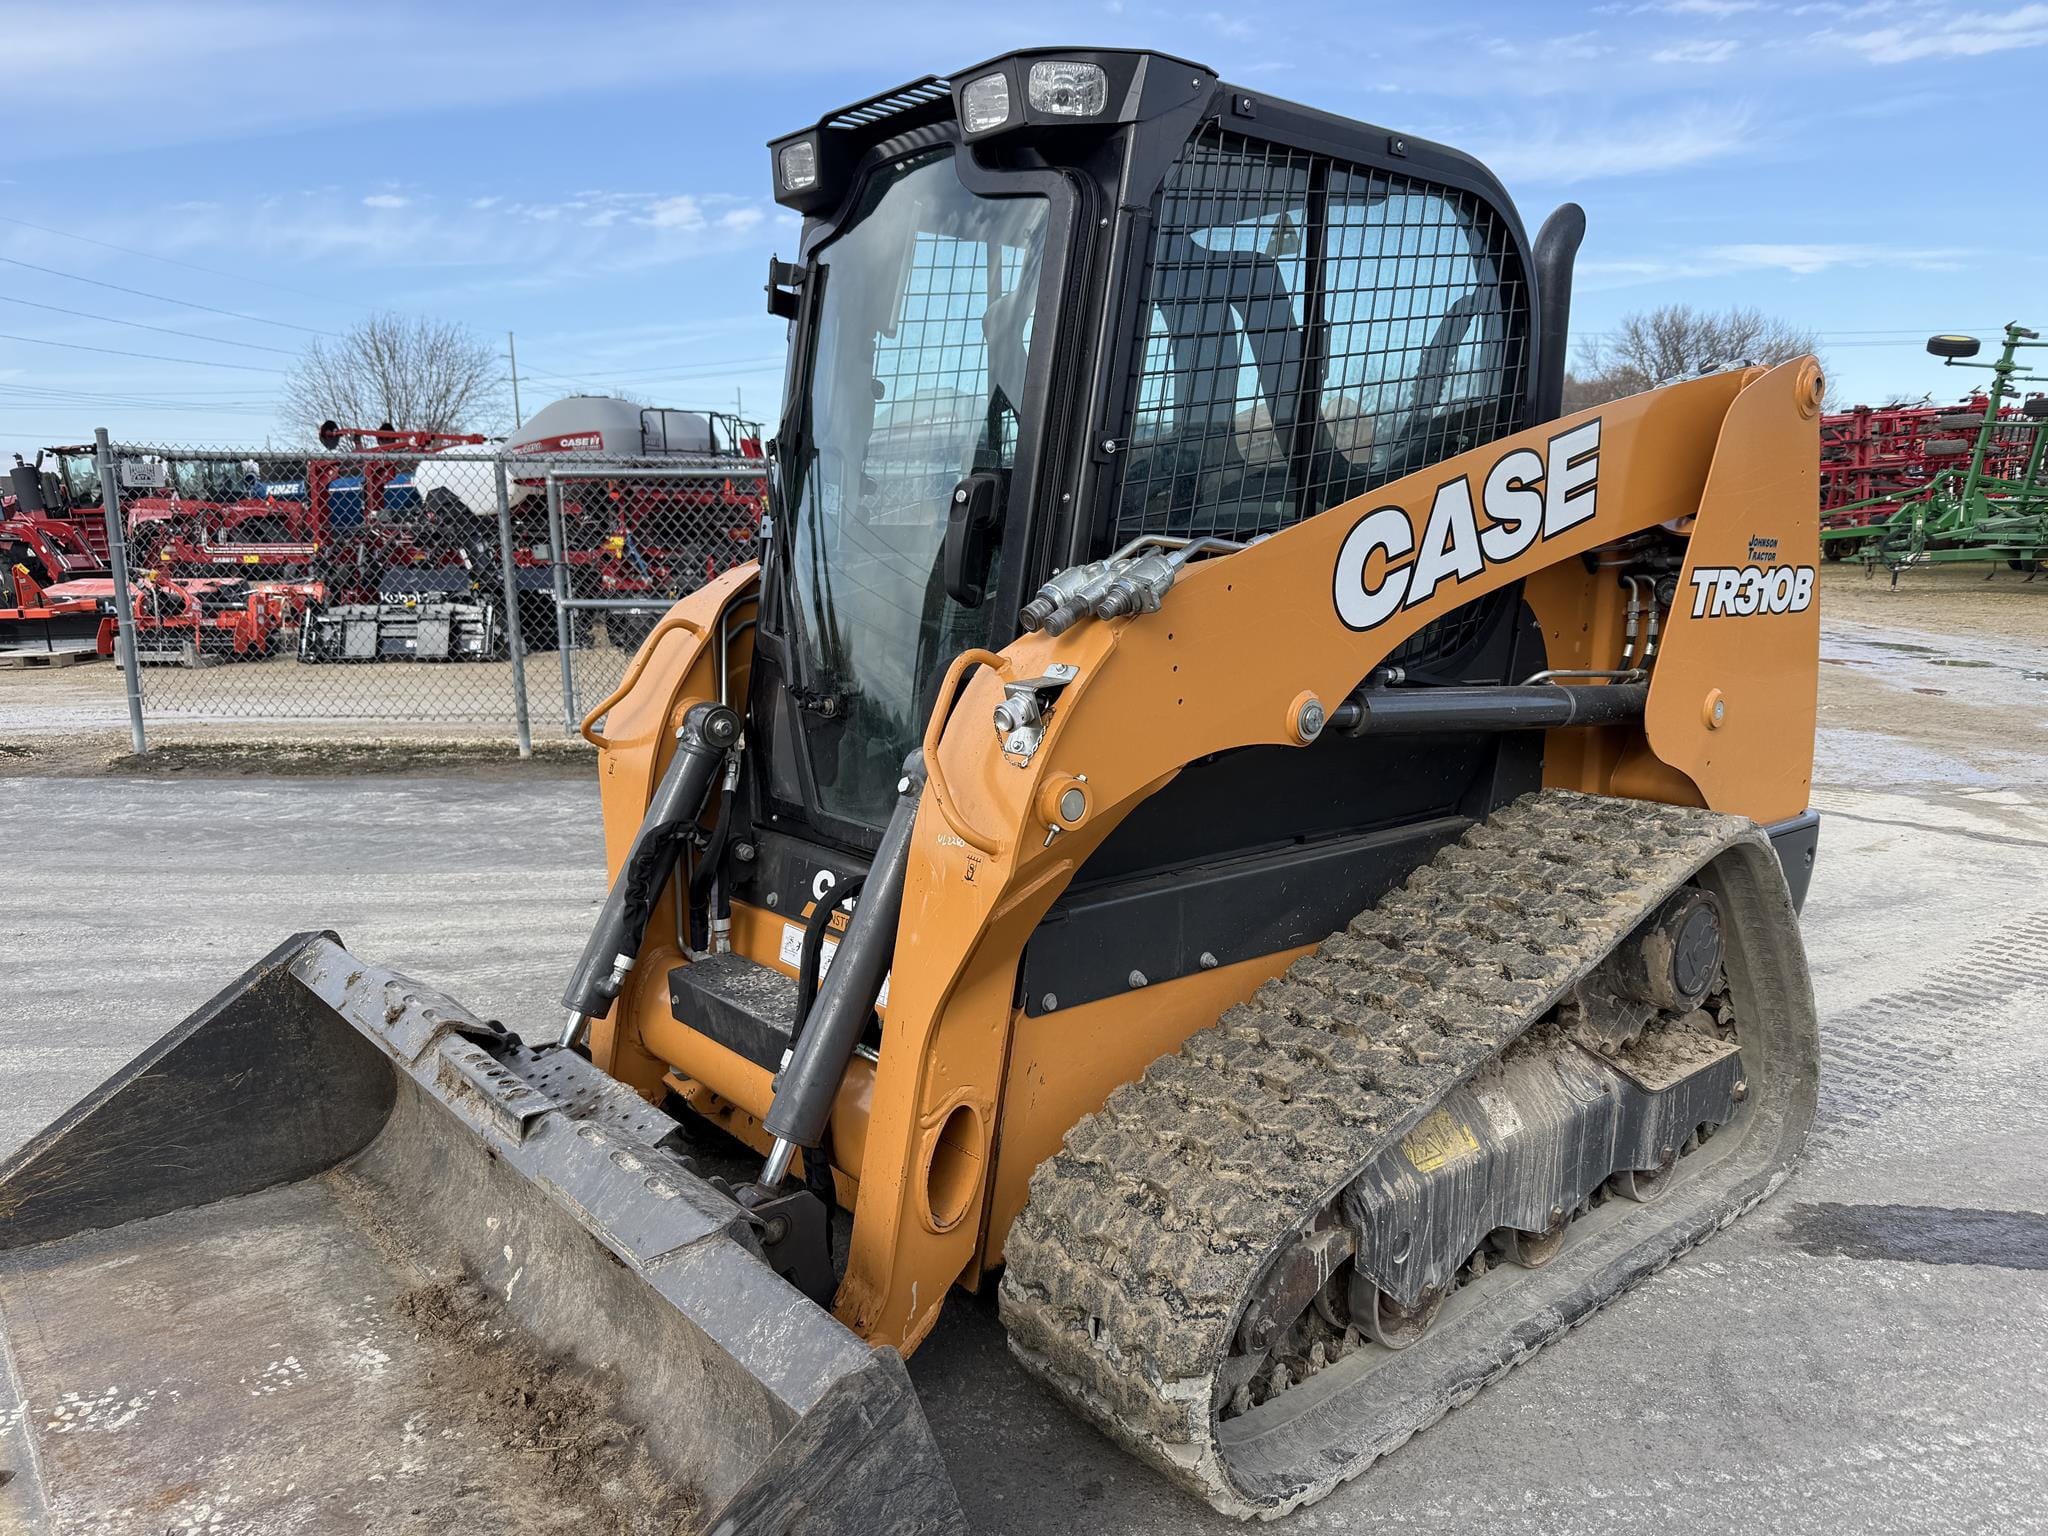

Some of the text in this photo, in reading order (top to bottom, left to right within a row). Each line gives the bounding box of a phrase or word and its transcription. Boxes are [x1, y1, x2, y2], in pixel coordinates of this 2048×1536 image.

[265, 483, 300, 496] KINZE
[1332, 416, 1602, 632] CASE
[1690, 564, 1815, 619] TR310B
